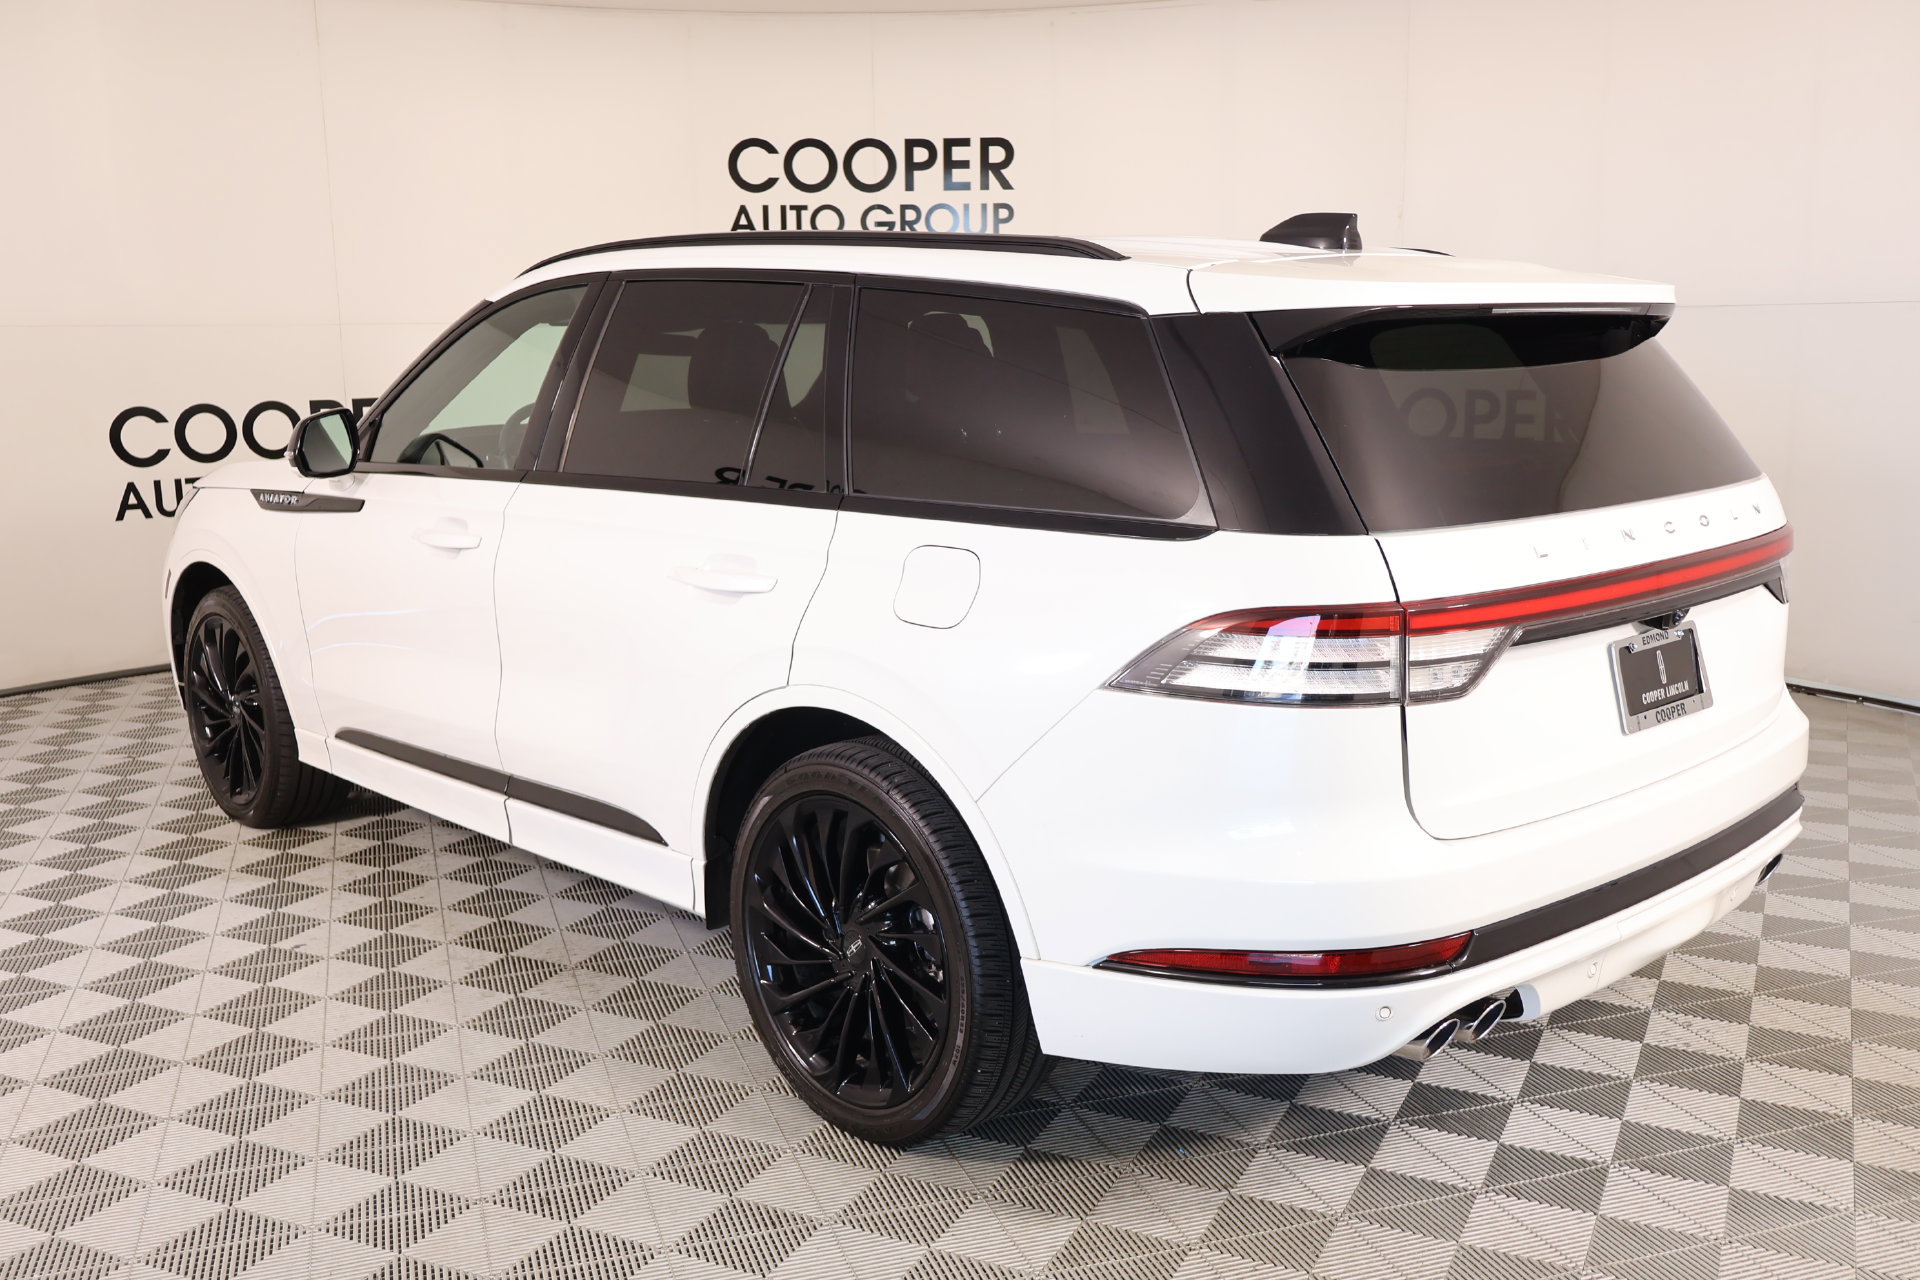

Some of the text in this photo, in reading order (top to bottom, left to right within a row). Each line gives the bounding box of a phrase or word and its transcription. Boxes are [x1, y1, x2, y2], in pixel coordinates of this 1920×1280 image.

[728, 137, 1015, 193] COOPER
[731, 203, 1015, 234] AUTO GROUP
[109, 398, 378, 467] COO
[1533, 503, 1762, 558] LINCOLN
[1642, 630, 1669, 645] EDMOND
[1642, 680, 1689, 704] COOPER LINCOLN
[1655, 703, 1687, 723] COOPER
